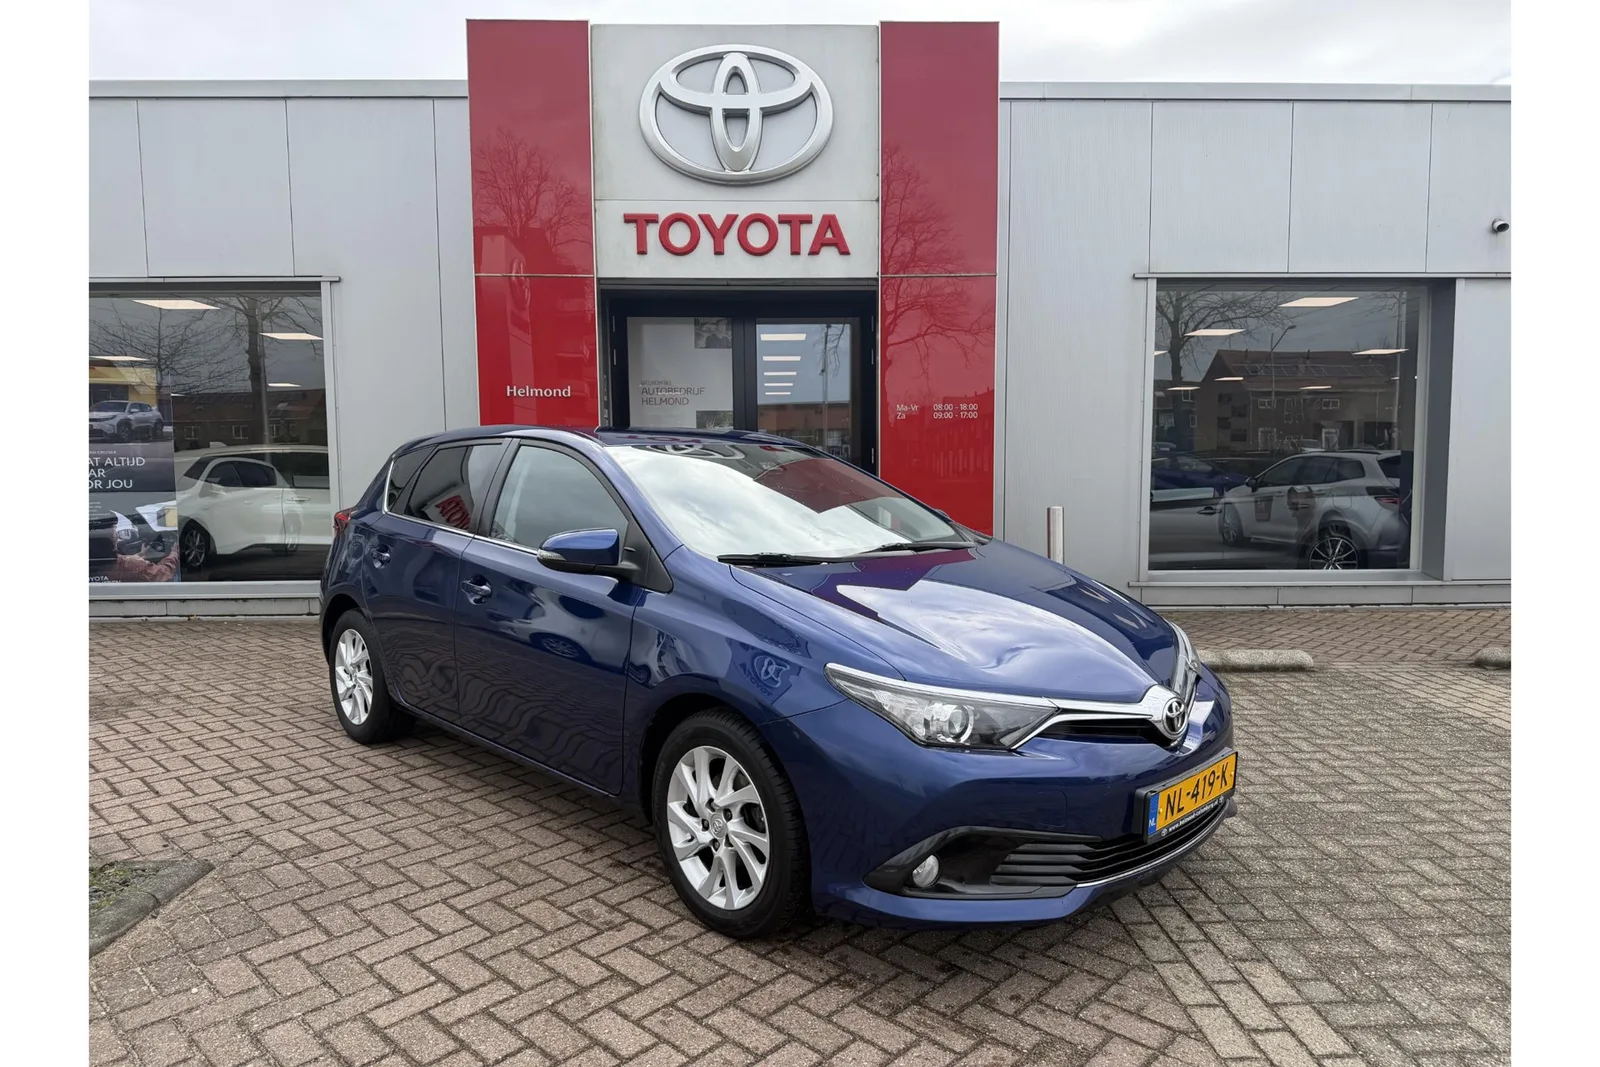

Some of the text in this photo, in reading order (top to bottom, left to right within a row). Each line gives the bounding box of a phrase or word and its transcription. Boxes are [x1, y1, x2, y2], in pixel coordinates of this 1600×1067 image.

[623, 212, 851, 256] TOYOTA
[506, 385, 571, 397] Helmond
[641, 386, 706, 396] AUTOBEDRIJF
[641, 396, 690, 406] HELMOND
[896, 404, 919, 412] Ma-Vr
[933, 403, 954, 411] 08:00
[960, 403, 979, 411] 18:00
[896, 412, 906, 420] Za
[933, 411, 954, 419] 09:00
[960, 411, 979, 419] 17:00
[104, 457, 146, 467] ALTIJD
[106, 479, 133, 489] JOU
[1164, 761, 1229, 820] NL-419-K
[1148, 818, 1156, 828] NL
